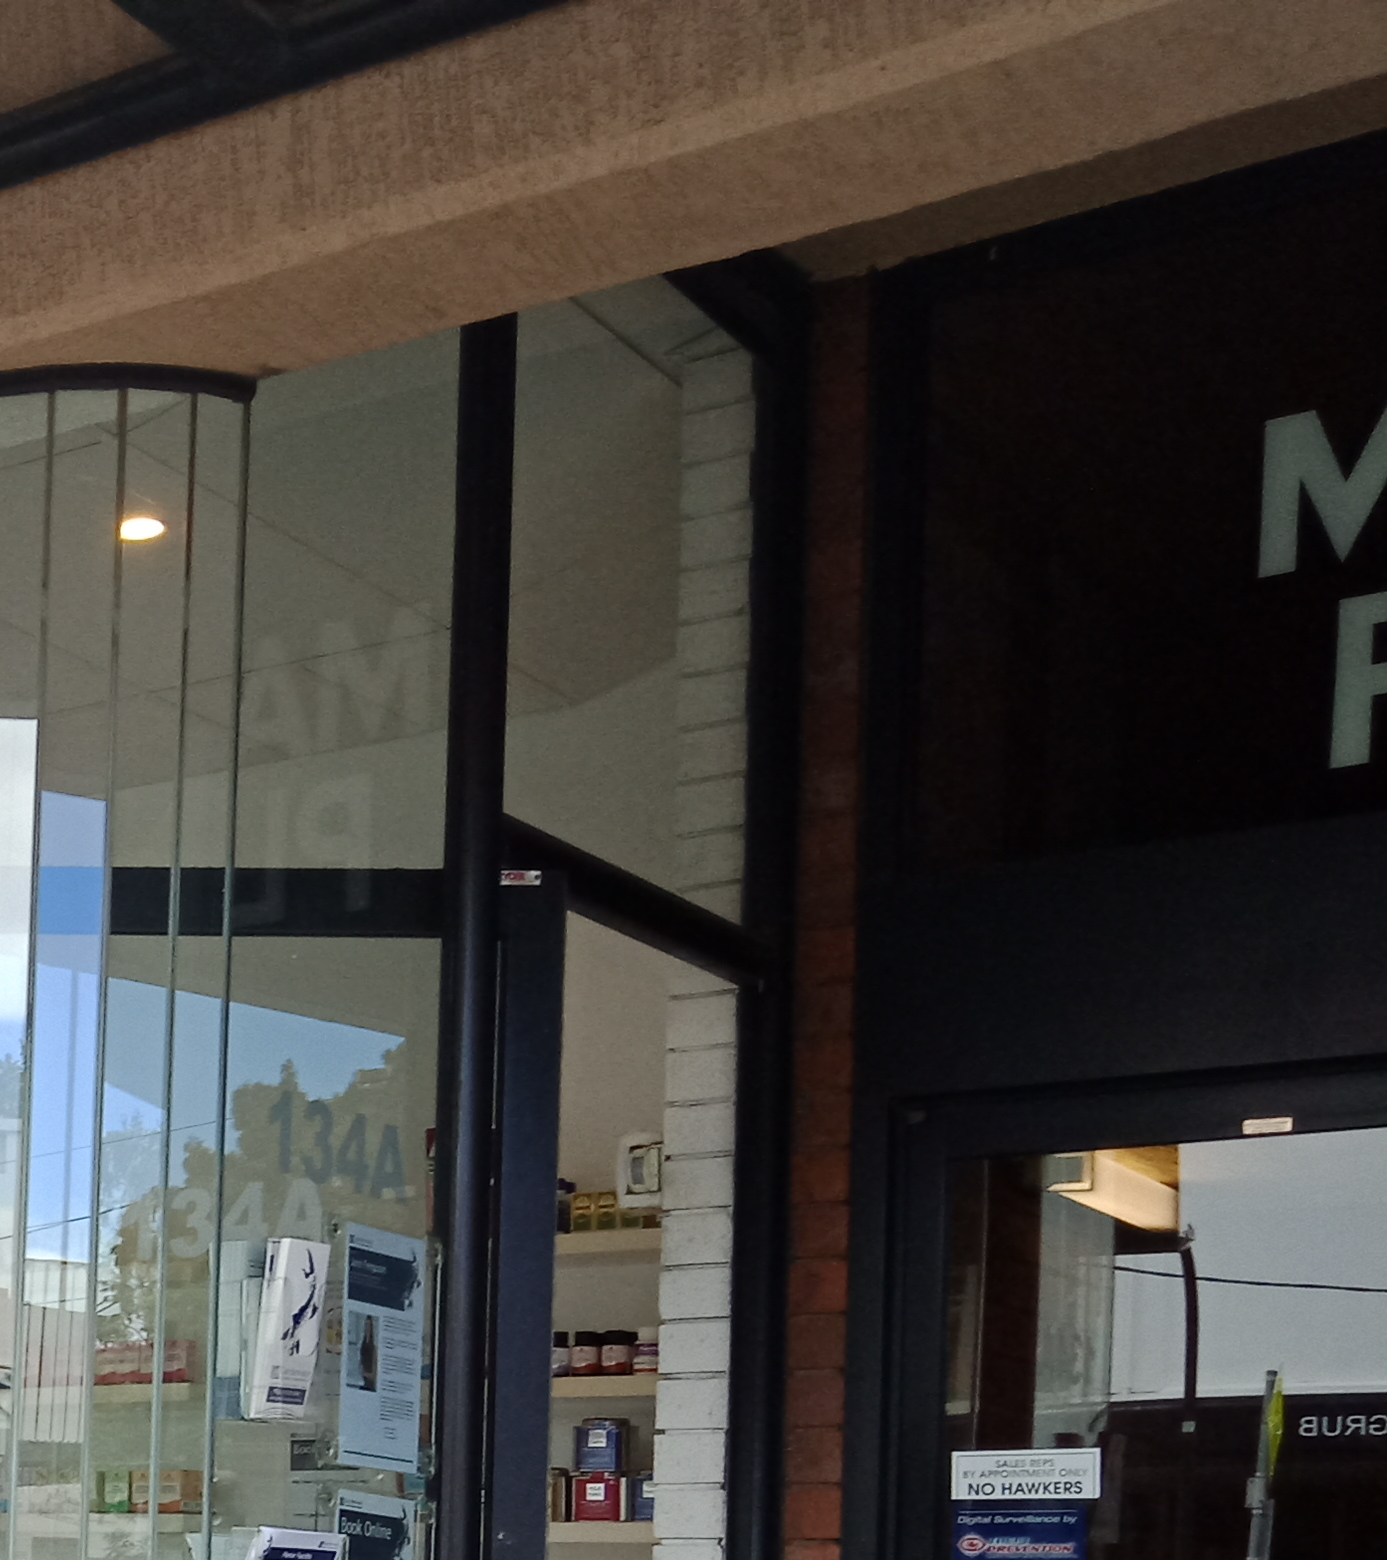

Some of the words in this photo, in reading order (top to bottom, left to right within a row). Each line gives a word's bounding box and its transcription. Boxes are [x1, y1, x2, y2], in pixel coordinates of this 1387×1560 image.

[268, 1091, 406, 1201] 134A
[995, 1459, 1027, 1468] SALES
[1029, 1458, 1055, 1468] REPS
[979, 1469, 1056, 1479] APPOINTMENT
[1058, 1468, 1088, 1477] ONLY
[967, 1482, 996, 1496] NO
[1001, 1481, 1083, 1495] HAWKERS
[957, 1515, 992, 1525] Digital
[1062, 1514, 1078, 1525] by
[340, 1516, 362, 1534] Book
[363, 1520, 393, 1540] Online
